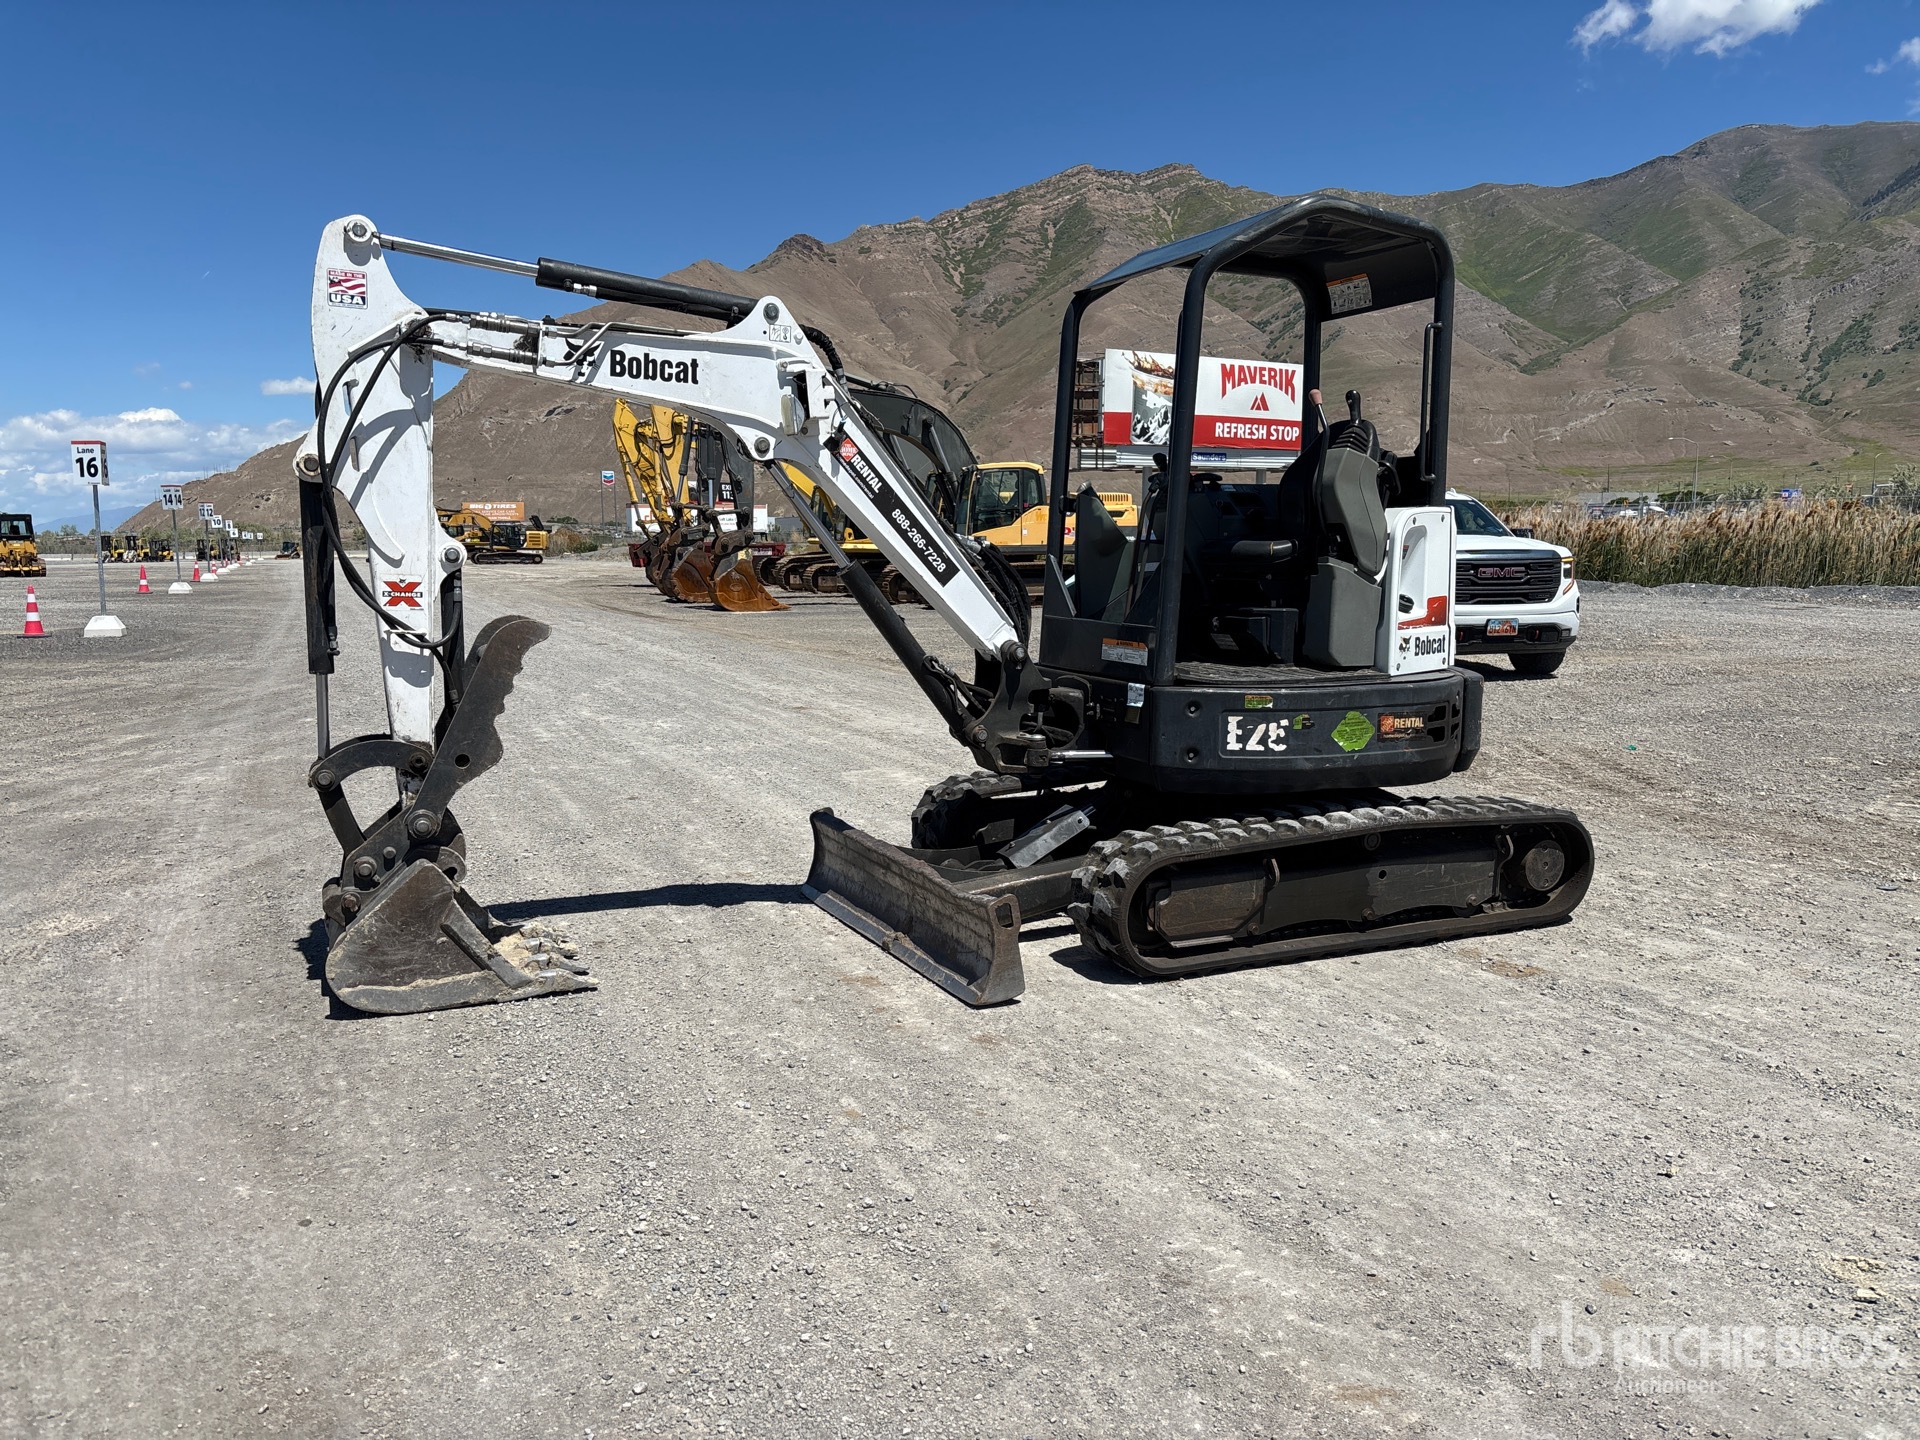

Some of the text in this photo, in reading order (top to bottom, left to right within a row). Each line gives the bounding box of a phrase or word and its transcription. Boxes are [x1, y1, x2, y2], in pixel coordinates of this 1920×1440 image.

[330, 293, 364, 304] USA
[609, 349, 699, 385] Bobcat
[1220, 363, 1297, 405] MAVERIK
[1215, 422, 1300, 441] REFRESH STOP
[76, 446, 95, 454] Lane
[1192, 453, 1226, 461] Saunders
[75, 457, 99, 478] 16
[850, 454, 882, 493] RENTAL
[163, 494, 173, 505] 14
[174, 494, 182, 505] 14
[206, 508, 213, 517] 12
[892, 509, 946, 572] 888-266-7228
[1478, 567, 1526, 577] GMC
[1414, 634, 1446, 657] Bobcat
[1394, 717, 1424, 728] RENTAL
